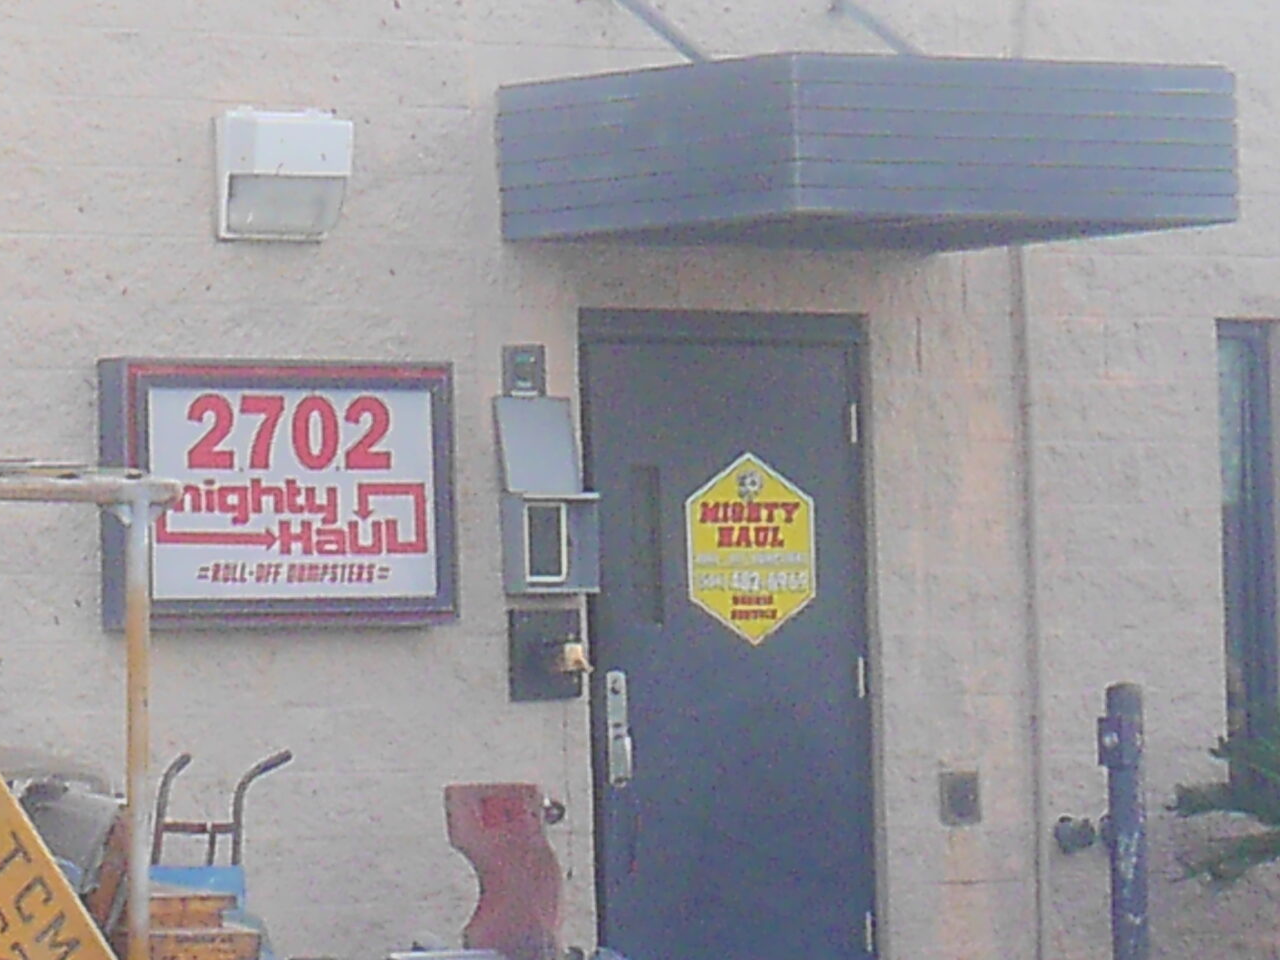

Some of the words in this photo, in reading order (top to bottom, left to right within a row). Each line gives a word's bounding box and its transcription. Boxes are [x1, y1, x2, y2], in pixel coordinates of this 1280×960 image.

[186, 393, 393, 471] 2702
[699, 501, 801, 524] MIGHTY
[716, 525, 785, 548] HAUL
